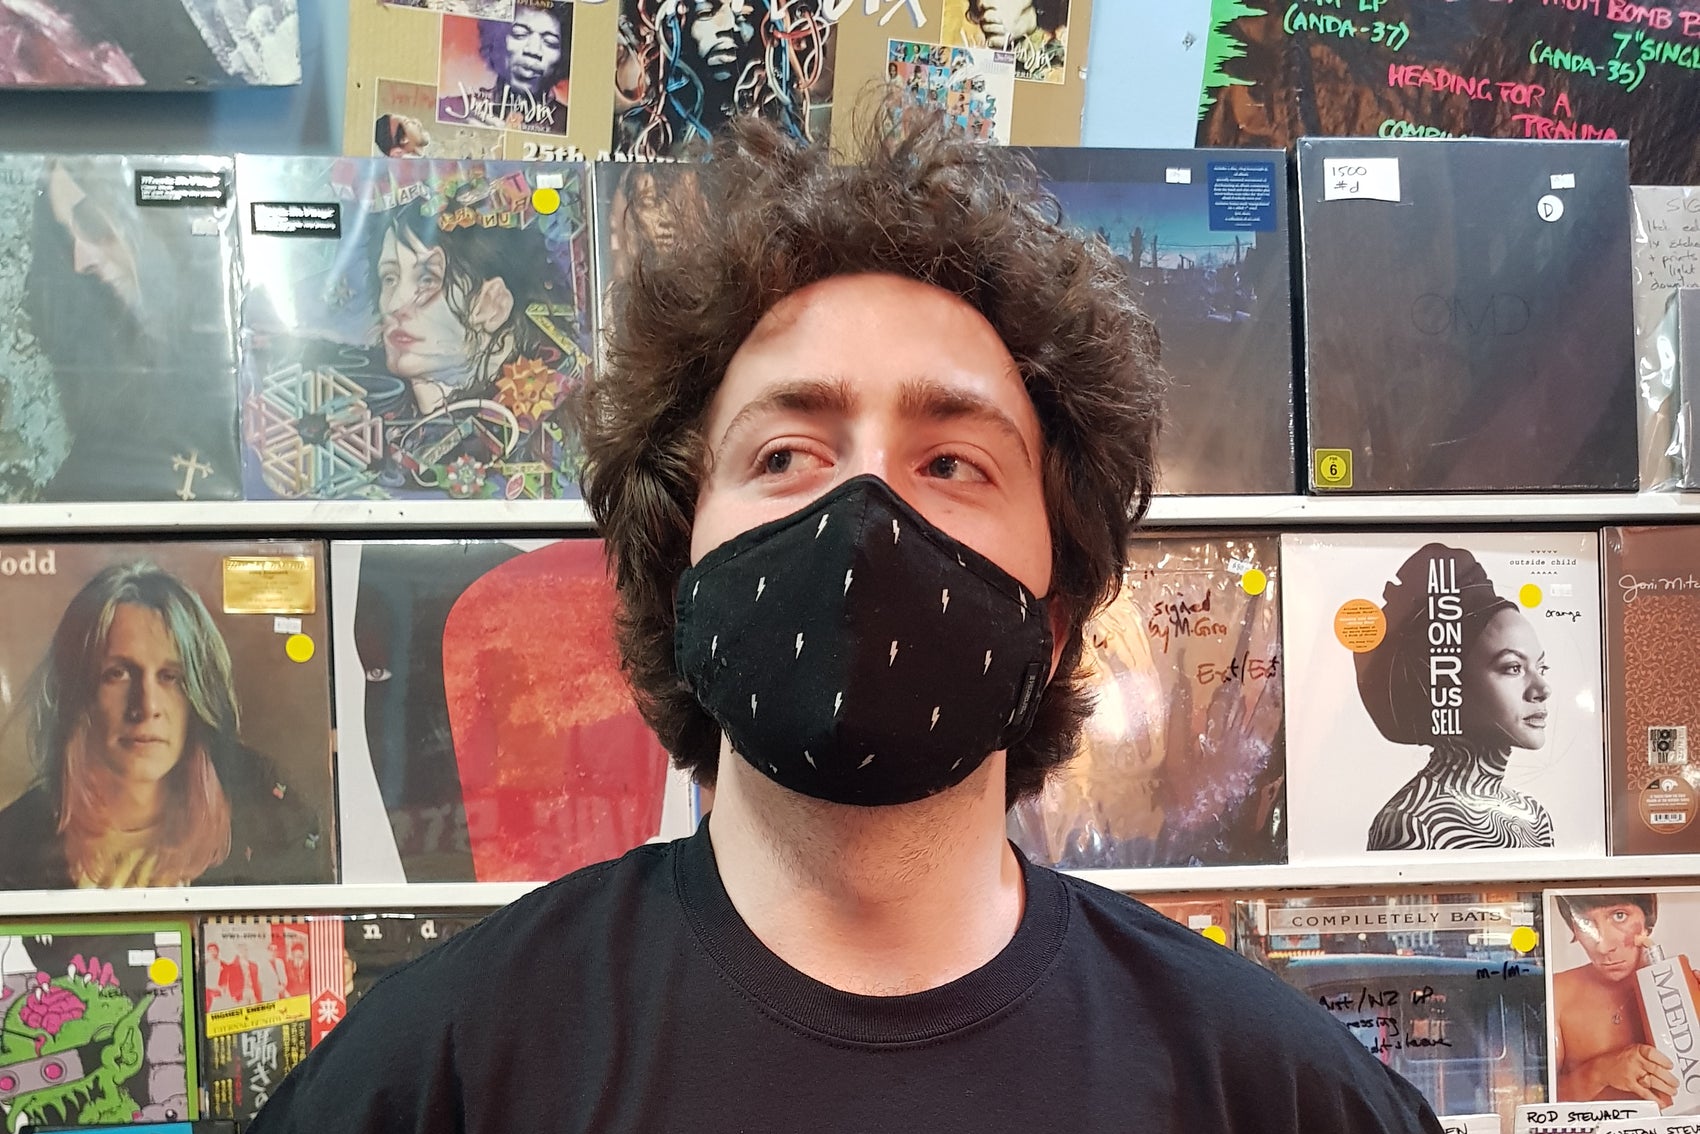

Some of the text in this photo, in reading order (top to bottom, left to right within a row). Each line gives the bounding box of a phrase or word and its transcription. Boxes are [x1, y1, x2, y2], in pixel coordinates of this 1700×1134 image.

[1283, 3, 1410, 52] (ANDA-37)
[1606, 1, 1673, 30] BOMB
[1529, 39, 1646, 93] (ANDA-35)
[1388, 63, 1572, 118] HEADING FOR A
[1332, 166, 1367, 177] 1500
[1543, 202, 1554, 218] D
[1410, 292, 1530, 336] OMD
[1330, 463, 1338, 476] 6
[1509, 558, 1577, 567] outside child
[1428, 558, 1460, 594] ALL
[1153, 588, 1212, 625] signed
[1428, 596, 1464, 621] IS
[1428, 622, 1462, 646] ON
[1430, 655, 1463, 686] R
[1431, 687, 1463, 708] US
[1431, 708, 1463, 736] SELL
[1291, 909, 1502, 927] COMPILETELY BATS
[1527, 1108, 1638, 1123] ROD STEWART
